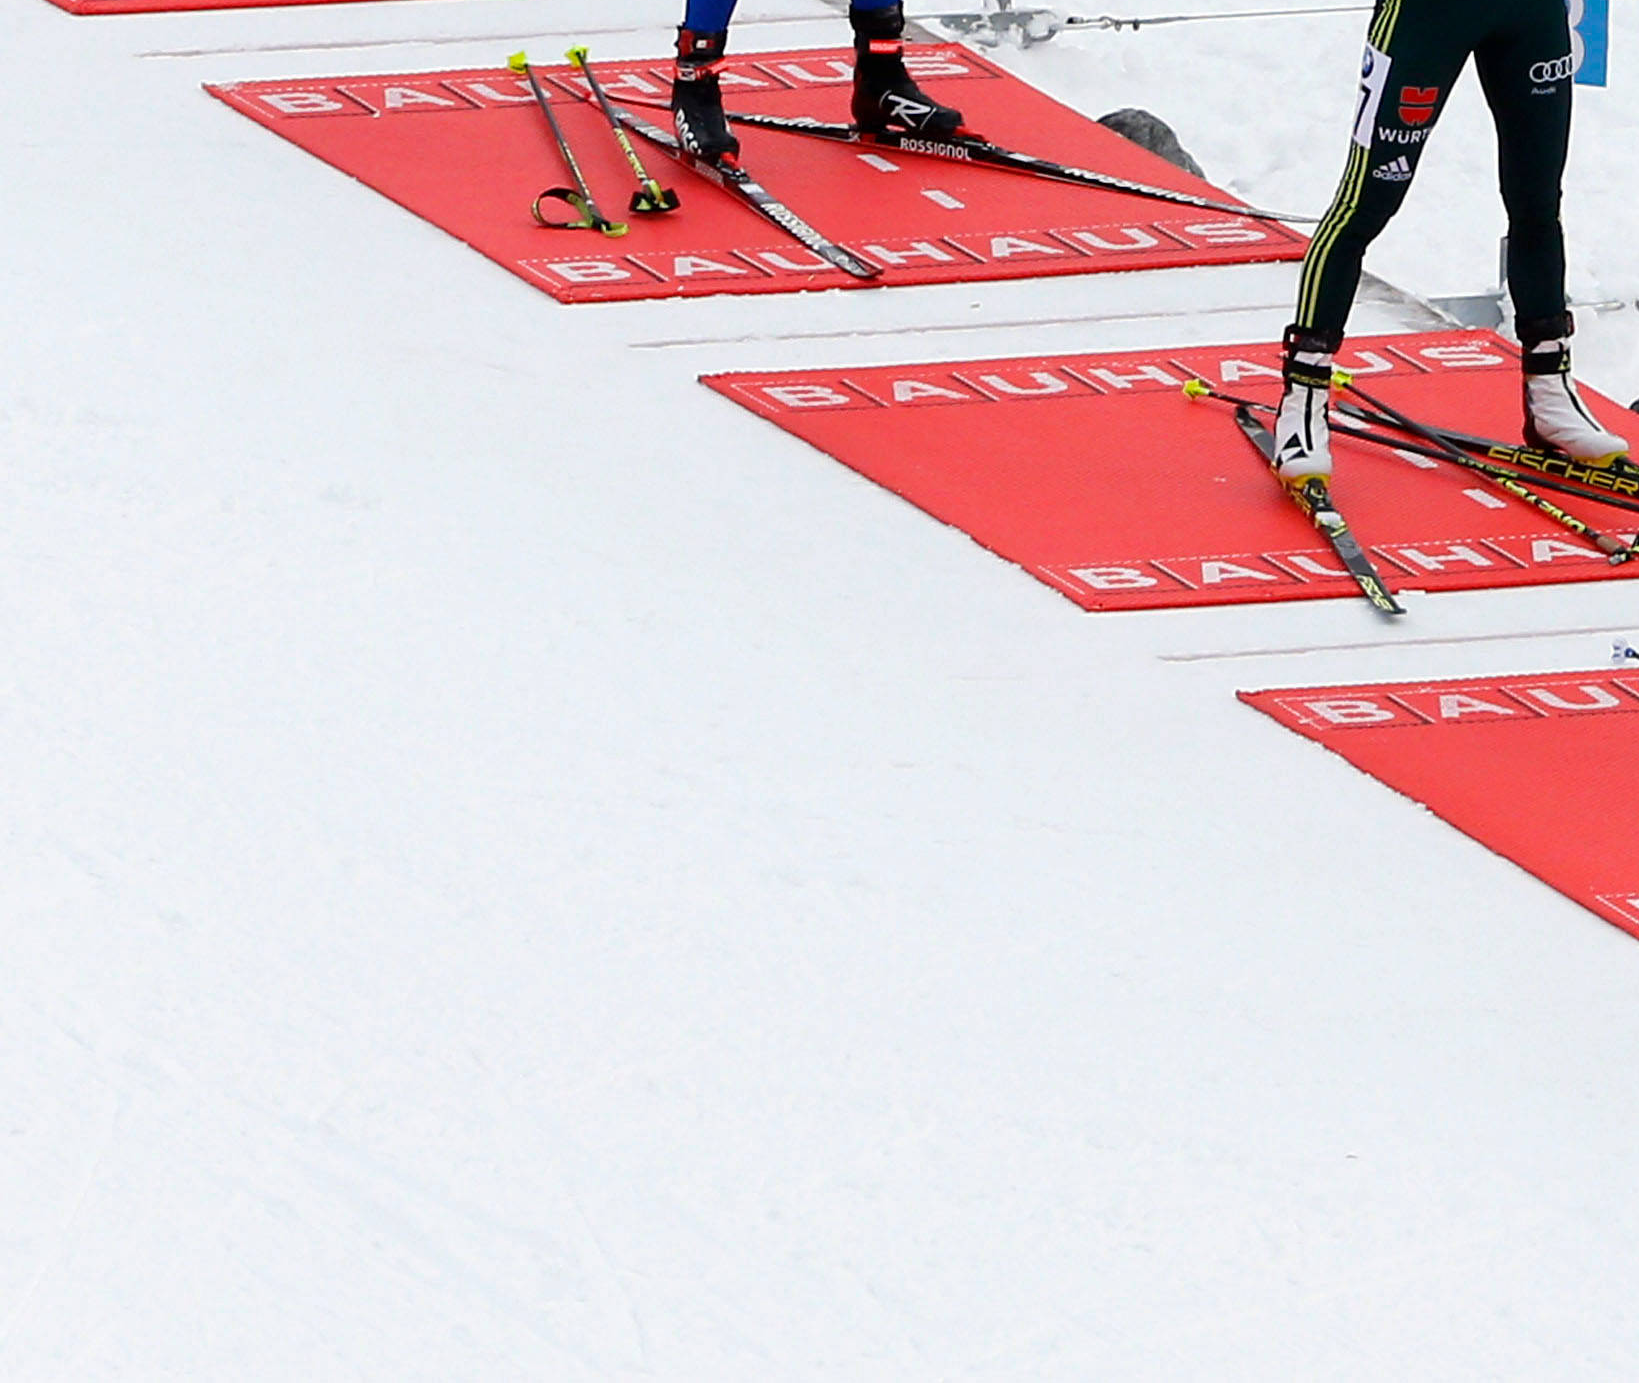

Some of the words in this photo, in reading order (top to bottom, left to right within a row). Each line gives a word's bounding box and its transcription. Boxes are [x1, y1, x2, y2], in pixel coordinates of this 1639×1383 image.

[900, 136, 972, 161] ROSSIGNOL
[1378, 126, 1431, 145] WÜRT
[544, 220, 1268, 283] BAUHAUS
[760, 345, 1504, 408] BAUHAUS
[1488, 445, 1639, 495] FISCHER
